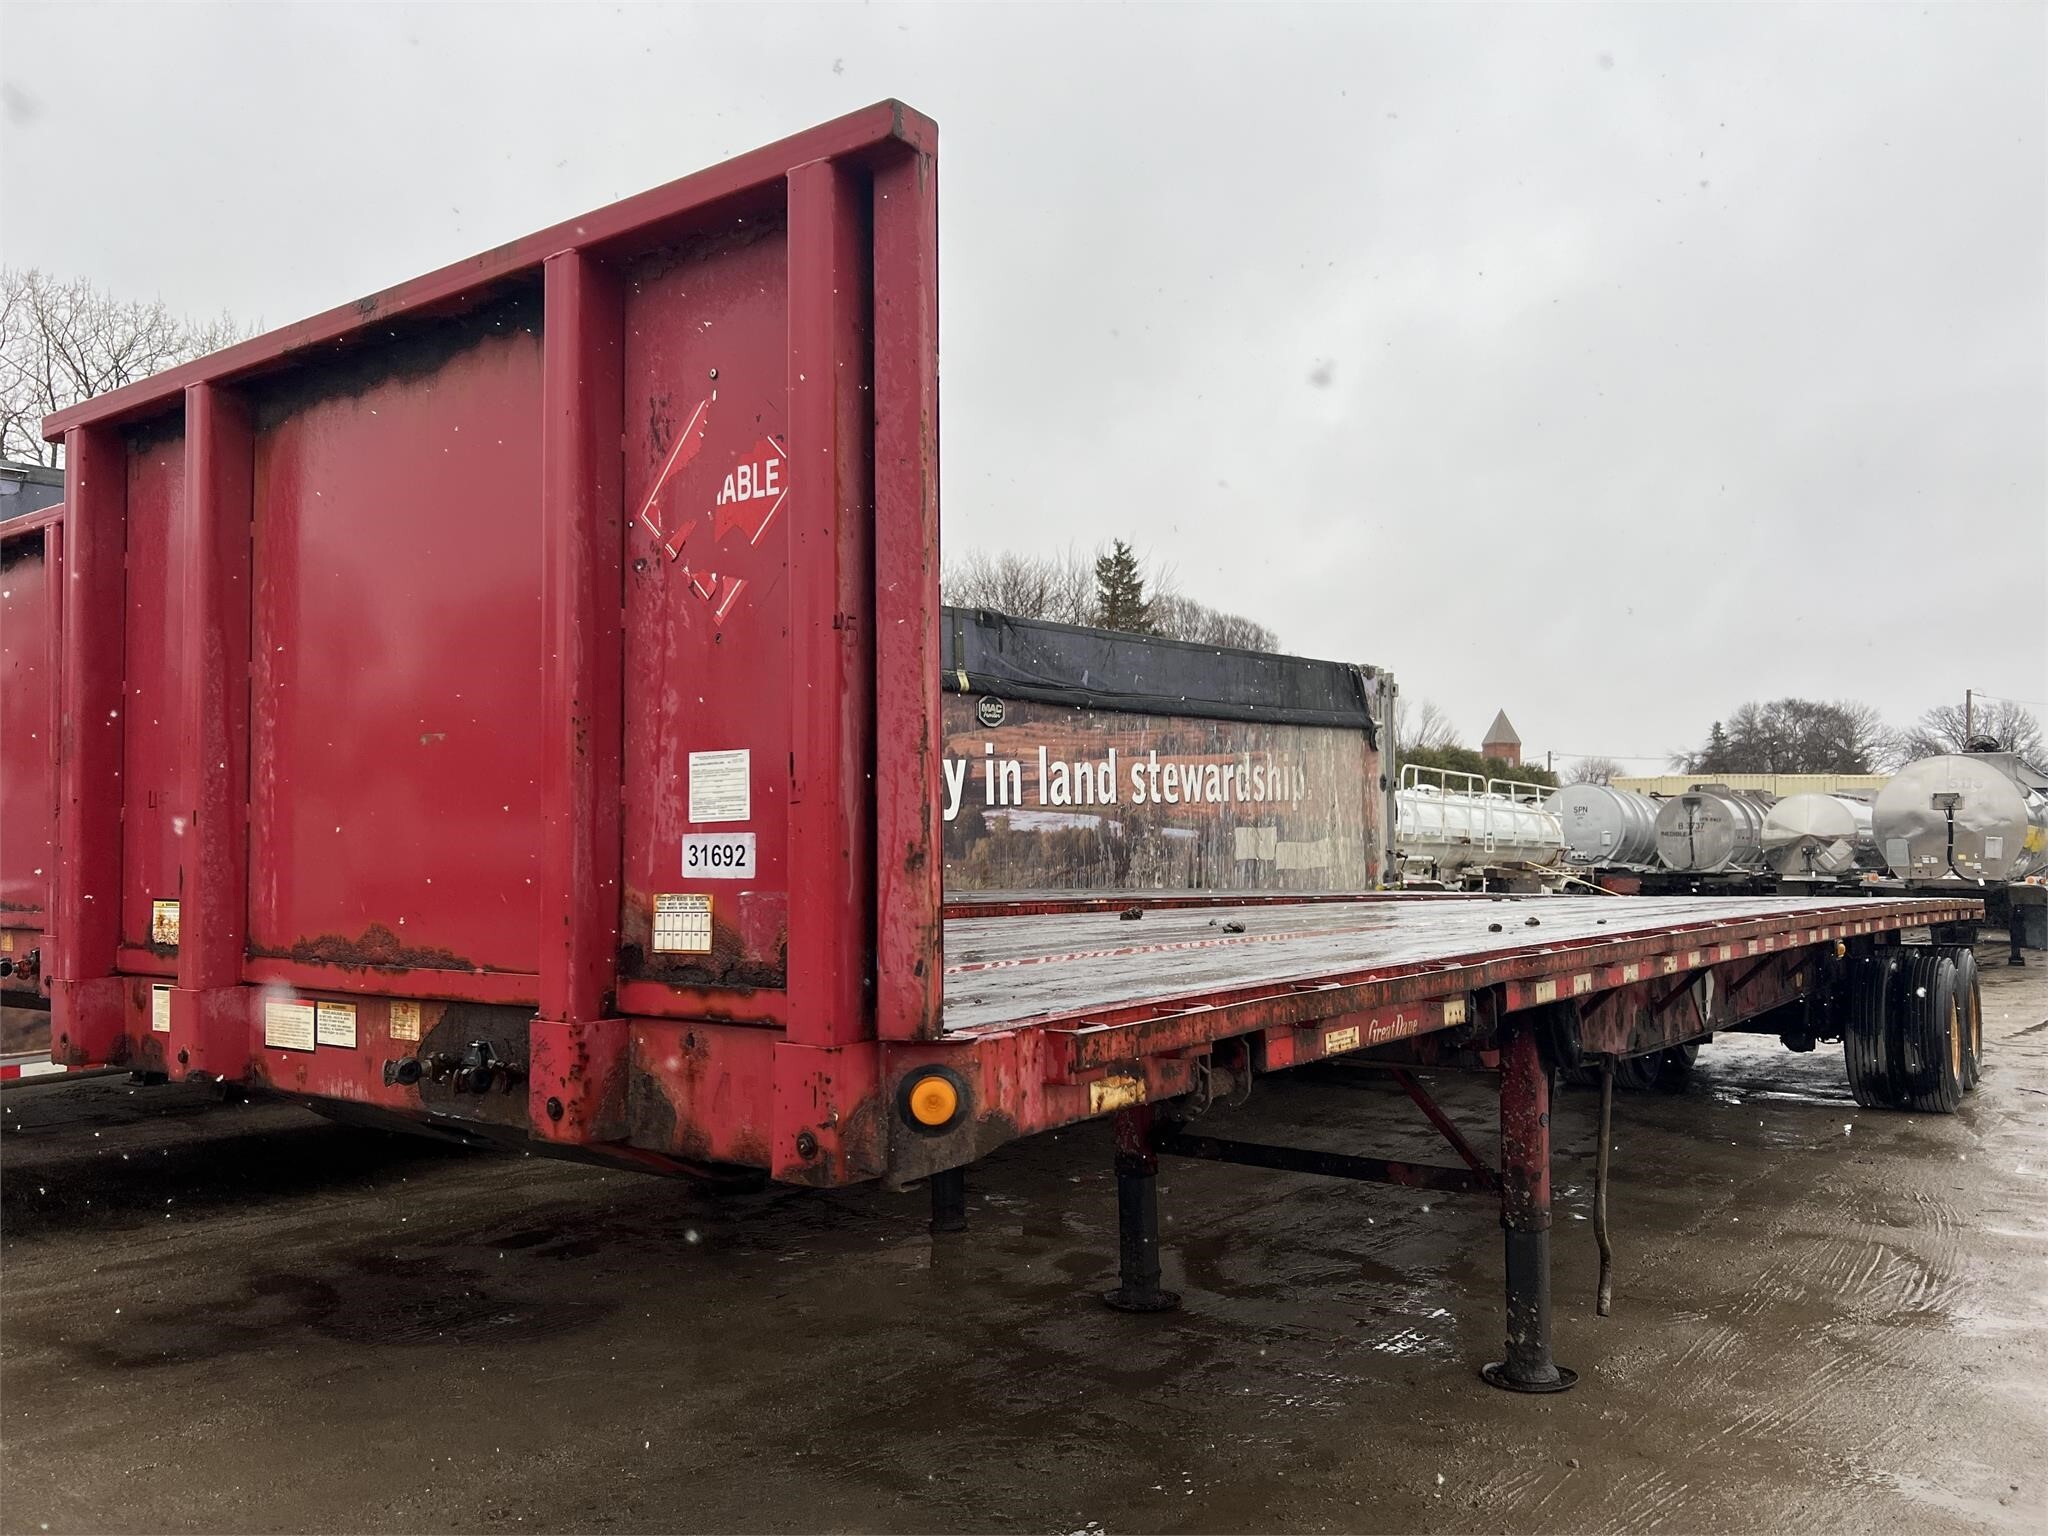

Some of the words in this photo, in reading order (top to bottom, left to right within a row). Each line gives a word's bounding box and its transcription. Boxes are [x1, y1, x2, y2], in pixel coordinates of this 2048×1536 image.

[981, 703, 1003, 714] MAC
[985, 742, 1022, 806] in
[1038, 745, 1118, 806] land
[1573, 805, 1588, 814] SPN
[688, 844, 746, 867] 31692
[1368, 1018, 1395, 1043] Great
[1393, 1014, 1418, 1037] Dane
